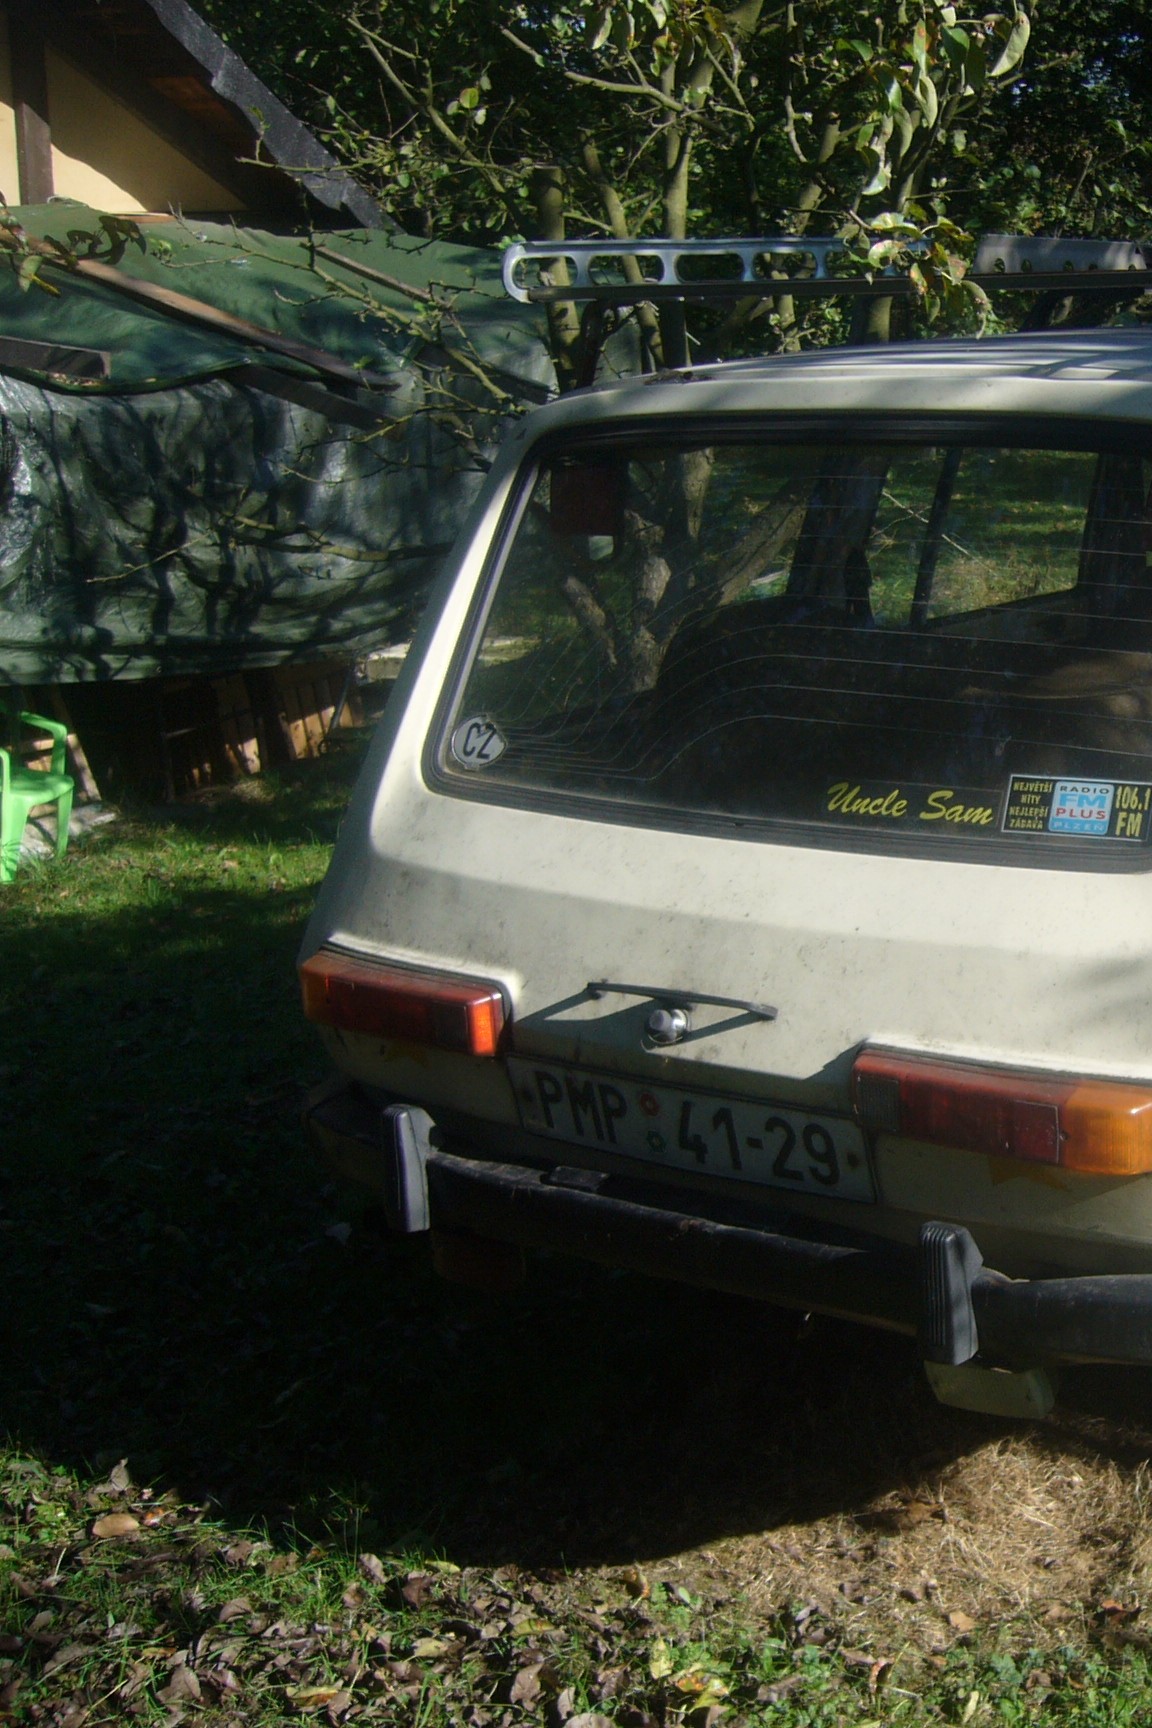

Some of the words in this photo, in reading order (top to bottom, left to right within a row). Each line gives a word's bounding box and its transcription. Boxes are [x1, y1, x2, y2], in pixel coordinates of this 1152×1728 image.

[463, 721, 497, 759] CZ
[1059, 793, 1107, 809] FM
[1060, 785, 1110, 795] RADIO
[1115, 785, 1151, 811] 106.1
[827, 782, 907, 817] Uncle
[919, 790, 993, 825] Sam
[1055, 807, 1106, 820] PLUS
[1115, 811, 1143, 837] FM
[535, 1070, 628, 1144] PMP
[678, 1101, 840, 1187] 41-29
